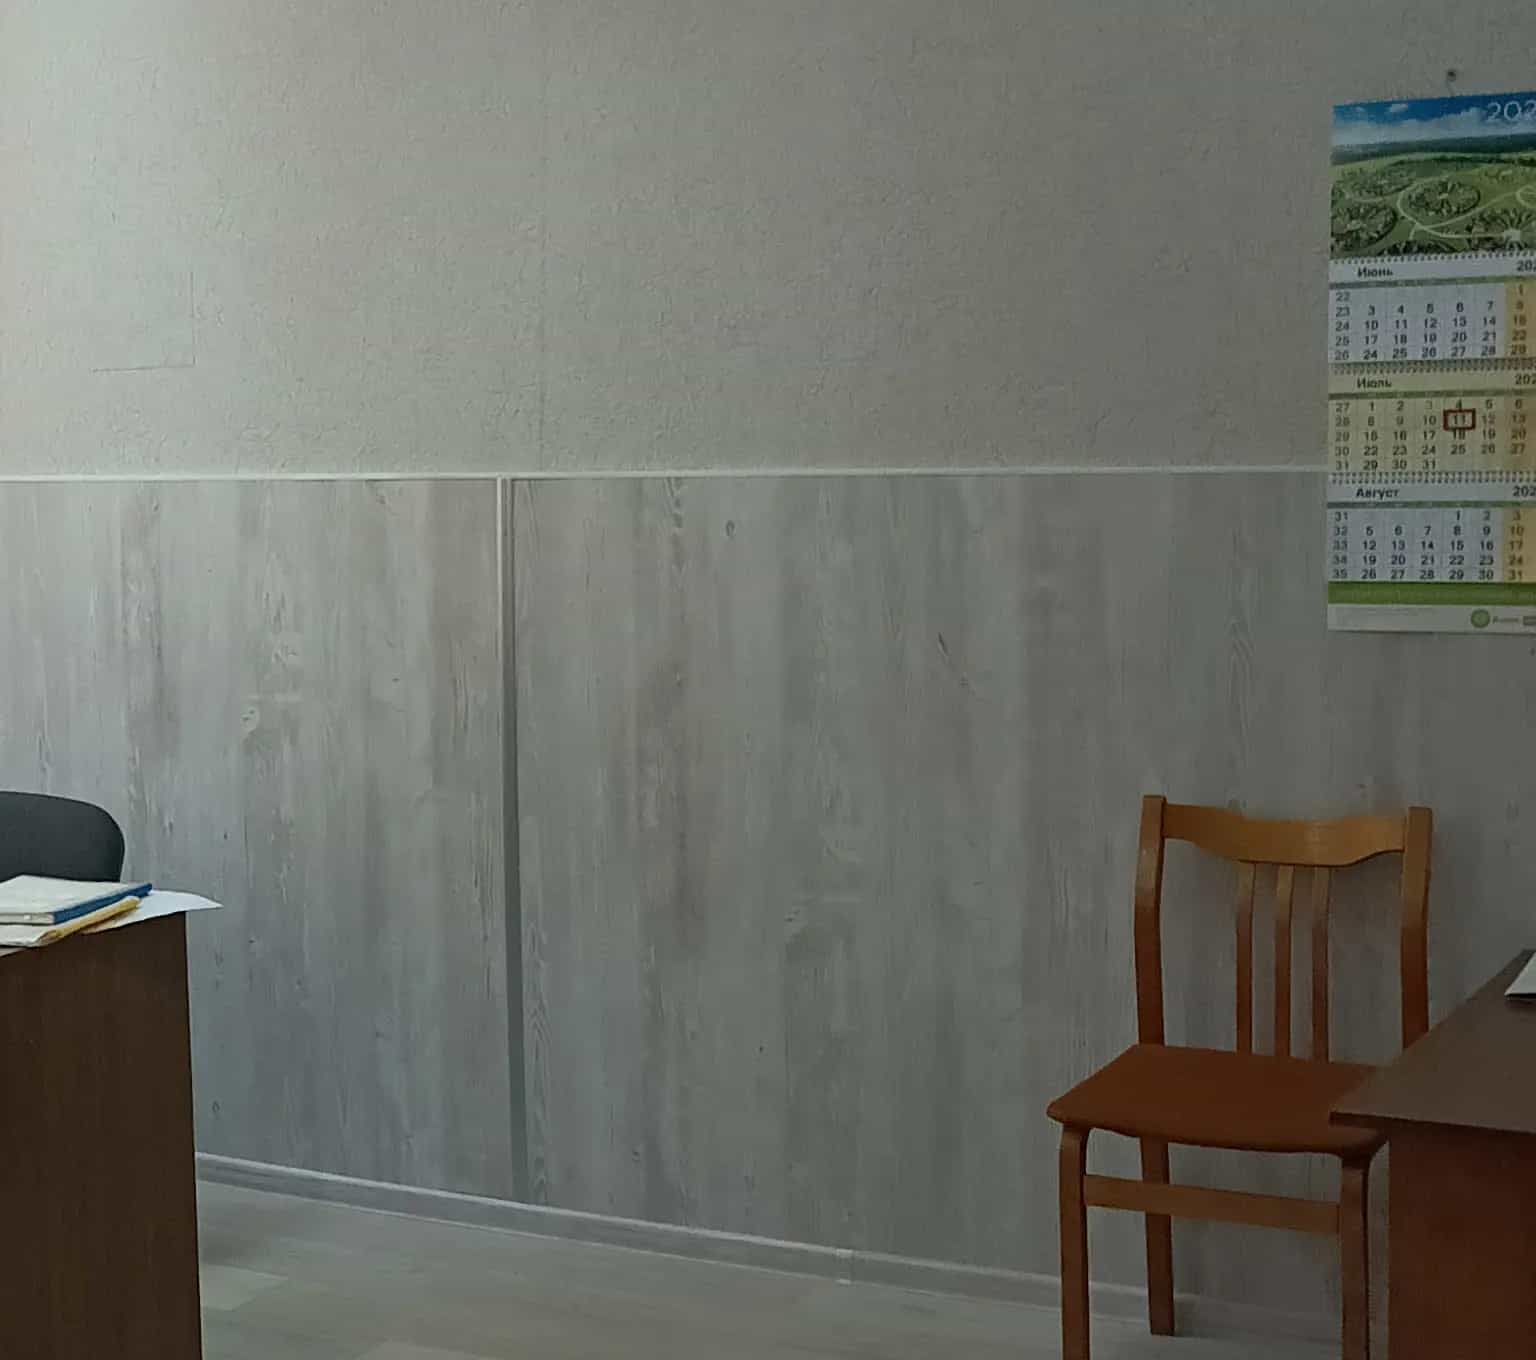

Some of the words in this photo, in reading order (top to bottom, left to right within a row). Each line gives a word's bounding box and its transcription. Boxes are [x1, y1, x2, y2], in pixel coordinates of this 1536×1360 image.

[1358, 267, 1392, 277] Июнь
[1357, 379, 1392, 388] Июль
[1454, 415, 1466, 424] 11
[1356, 488, 1399, 501] Август
